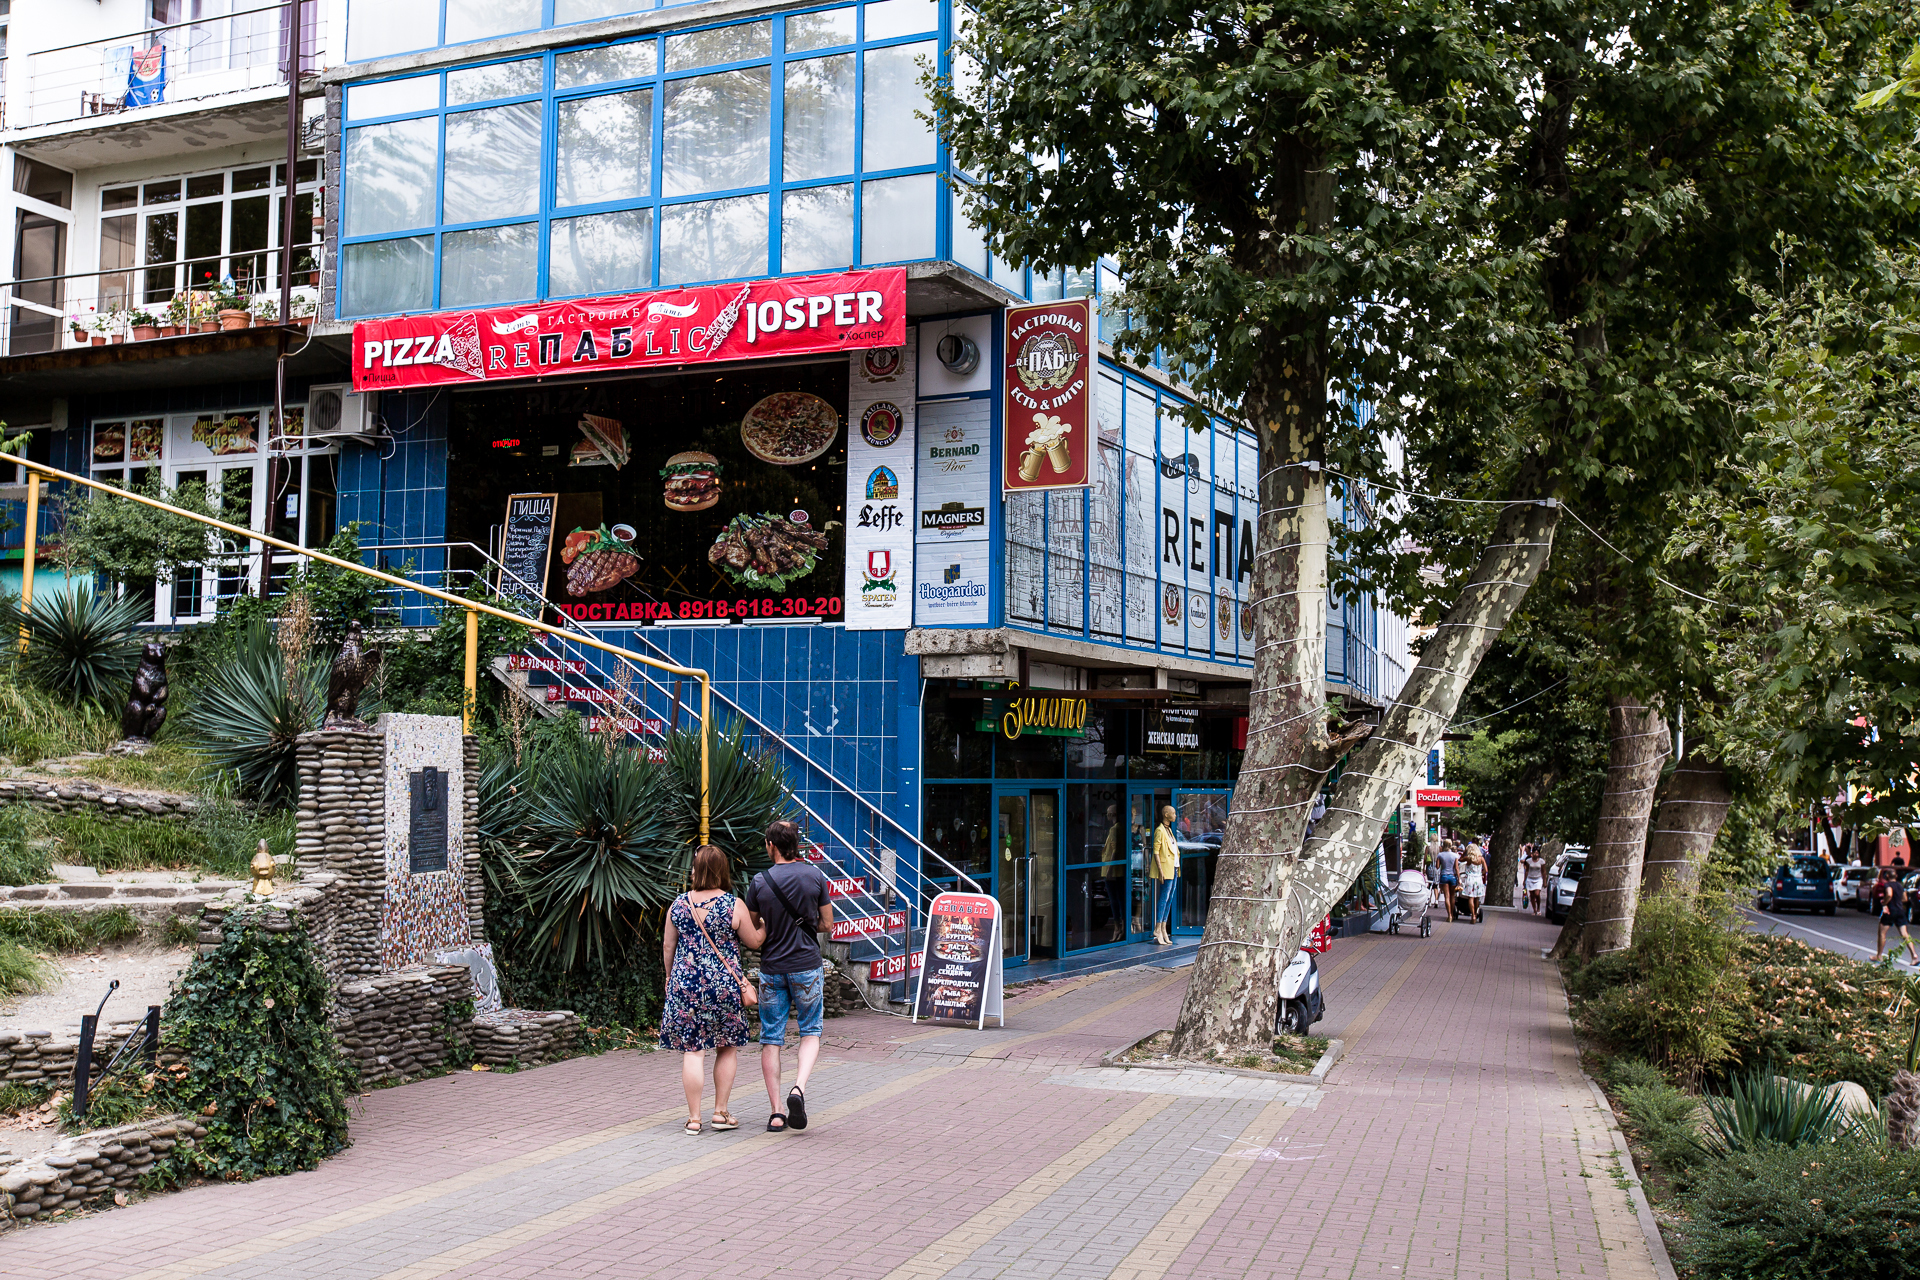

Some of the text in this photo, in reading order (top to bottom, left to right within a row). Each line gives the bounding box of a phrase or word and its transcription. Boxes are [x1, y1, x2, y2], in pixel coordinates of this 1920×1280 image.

[548, 307, 640, 326] ГАСТРОПАБ
[746, 291, 883, 344] JOSPER
[1011, 313, 1084, 340] ГАСТРОПАБ
[846, 328, 885, 341] Хоспер
[363, 333, 456, 370] PIZZA
[368, 373, 396, 383] Пицца
[1010, 379, 1084, 410] ЕСТЬ & ПИТЬ
[863, 403, 900, 421] PAULANER
[194, 433, 236, 448] Matteo
[492, 439, 520, 448] ОТКРЫТО
[930, 444, 980, 458] BERNARD
[941, 459, 966, 472] Pivo
[512, 499, 551, 516] ПИЦЦА
[856, 504, 903, 532] Leffe
[924, 511, 981, 526] MAGNERS
[919, 580, 986, 601] Hoegaarden
[557, 597, 841, 623] ДОСТАВКА 8918-618-30-20
[520, 658, 575, 672] 8-918-618-3-20
[569, 690, 602, 700] САЛАТЫ
[1148, 731, 1198, 748] ЖЕНСКАЯ ОДЕЖДА
[1418, 793, 1460, 802] РосДеньги
[836, 914, 901, 936] МОРЕПРОДУТЫ
[950, 923, 972, 931] ПИЦЦА
[938, 969, 972, 977] СЕНДВИЧИ
[927, 977, 979, 988] МОРЕПРОДУКТЫ
[934, 999, 966, 1008] ШАШЛЫК
